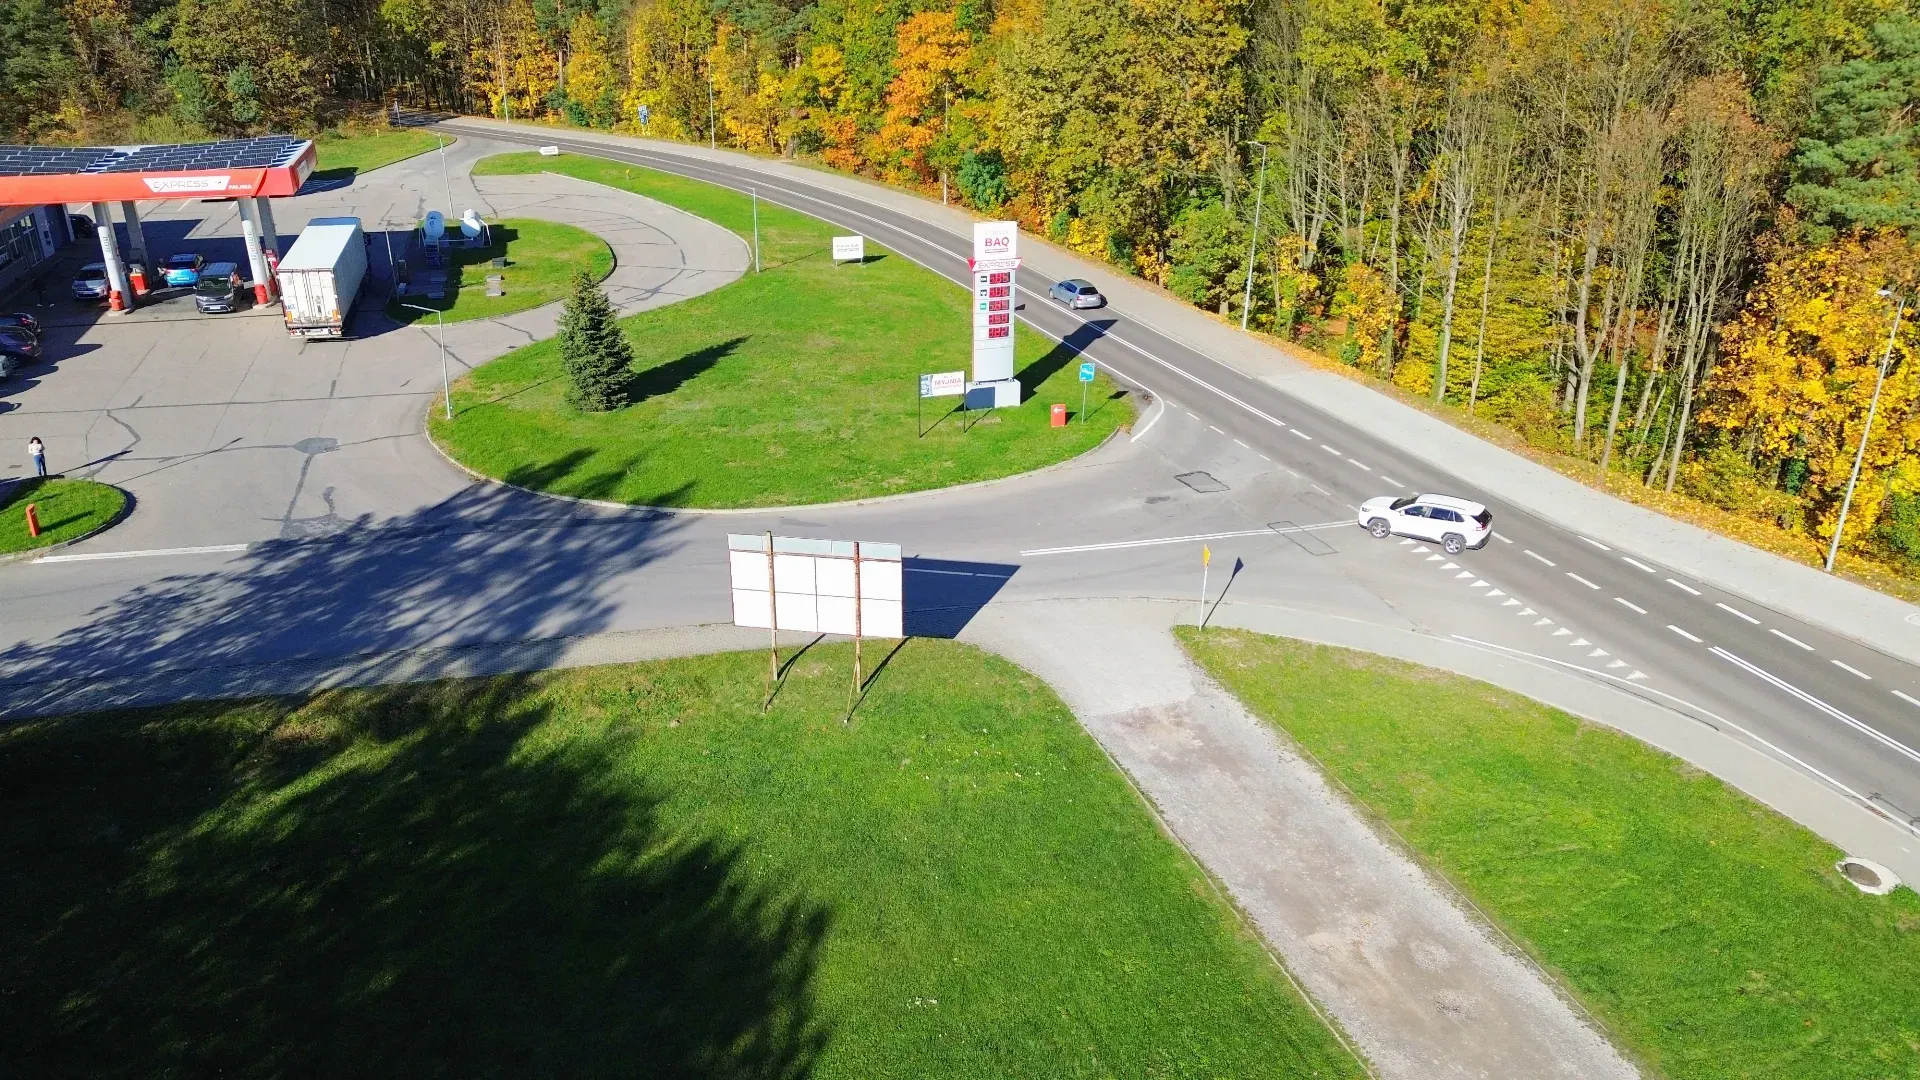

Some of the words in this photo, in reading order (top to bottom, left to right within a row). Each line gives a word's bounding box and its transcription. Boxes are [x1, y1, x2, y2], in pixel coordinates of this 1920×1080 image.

[153, 180, 209, 190] EXPRESS
[985, 236, 1010, 247] BAQ
[978, 261, 1016, 269] EXPRESS
[934, 377, 962, 386] MYJNIA
